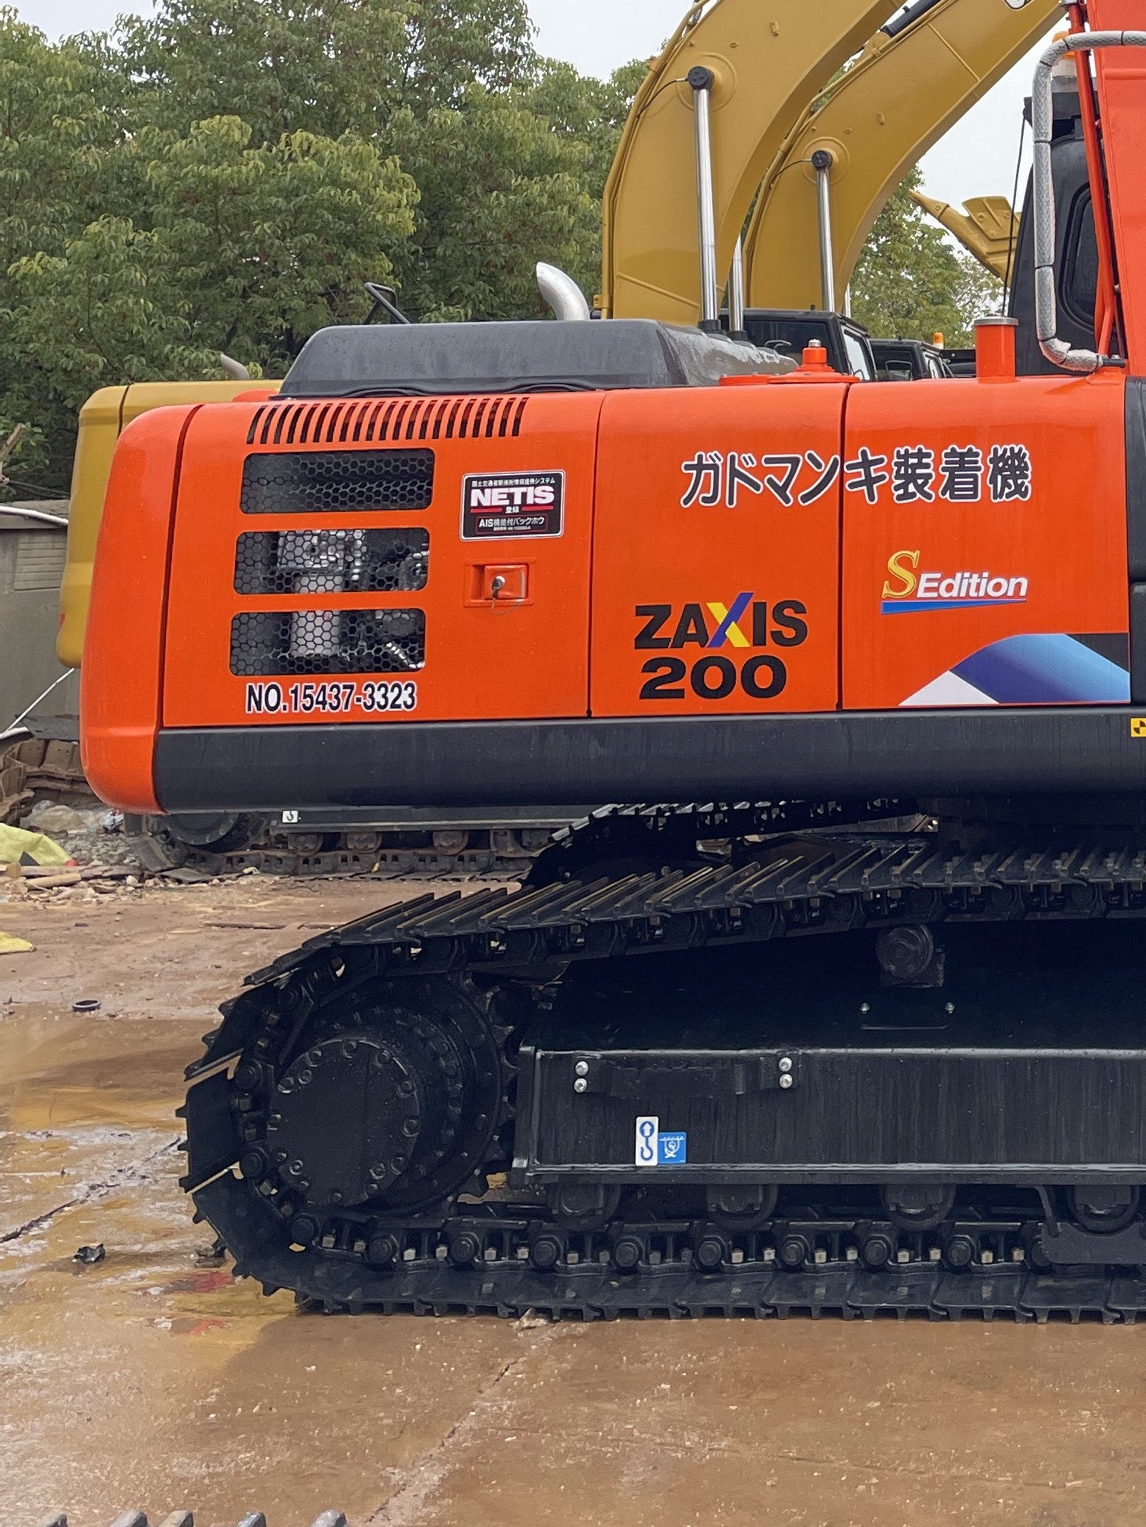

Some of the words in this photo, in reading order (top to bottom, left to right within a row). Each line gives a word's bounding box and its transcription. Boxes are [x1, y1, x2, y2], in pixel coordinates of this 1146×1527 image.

[470, 485, 555, 507] NETIS
[681, 445, 1032, 508] ガドマンキ装着機
[634, 592, 808, 649] ZAXIS
[246, 681, 417, 713] NO.15437-3323
[638, 655, 787, 700] 200
